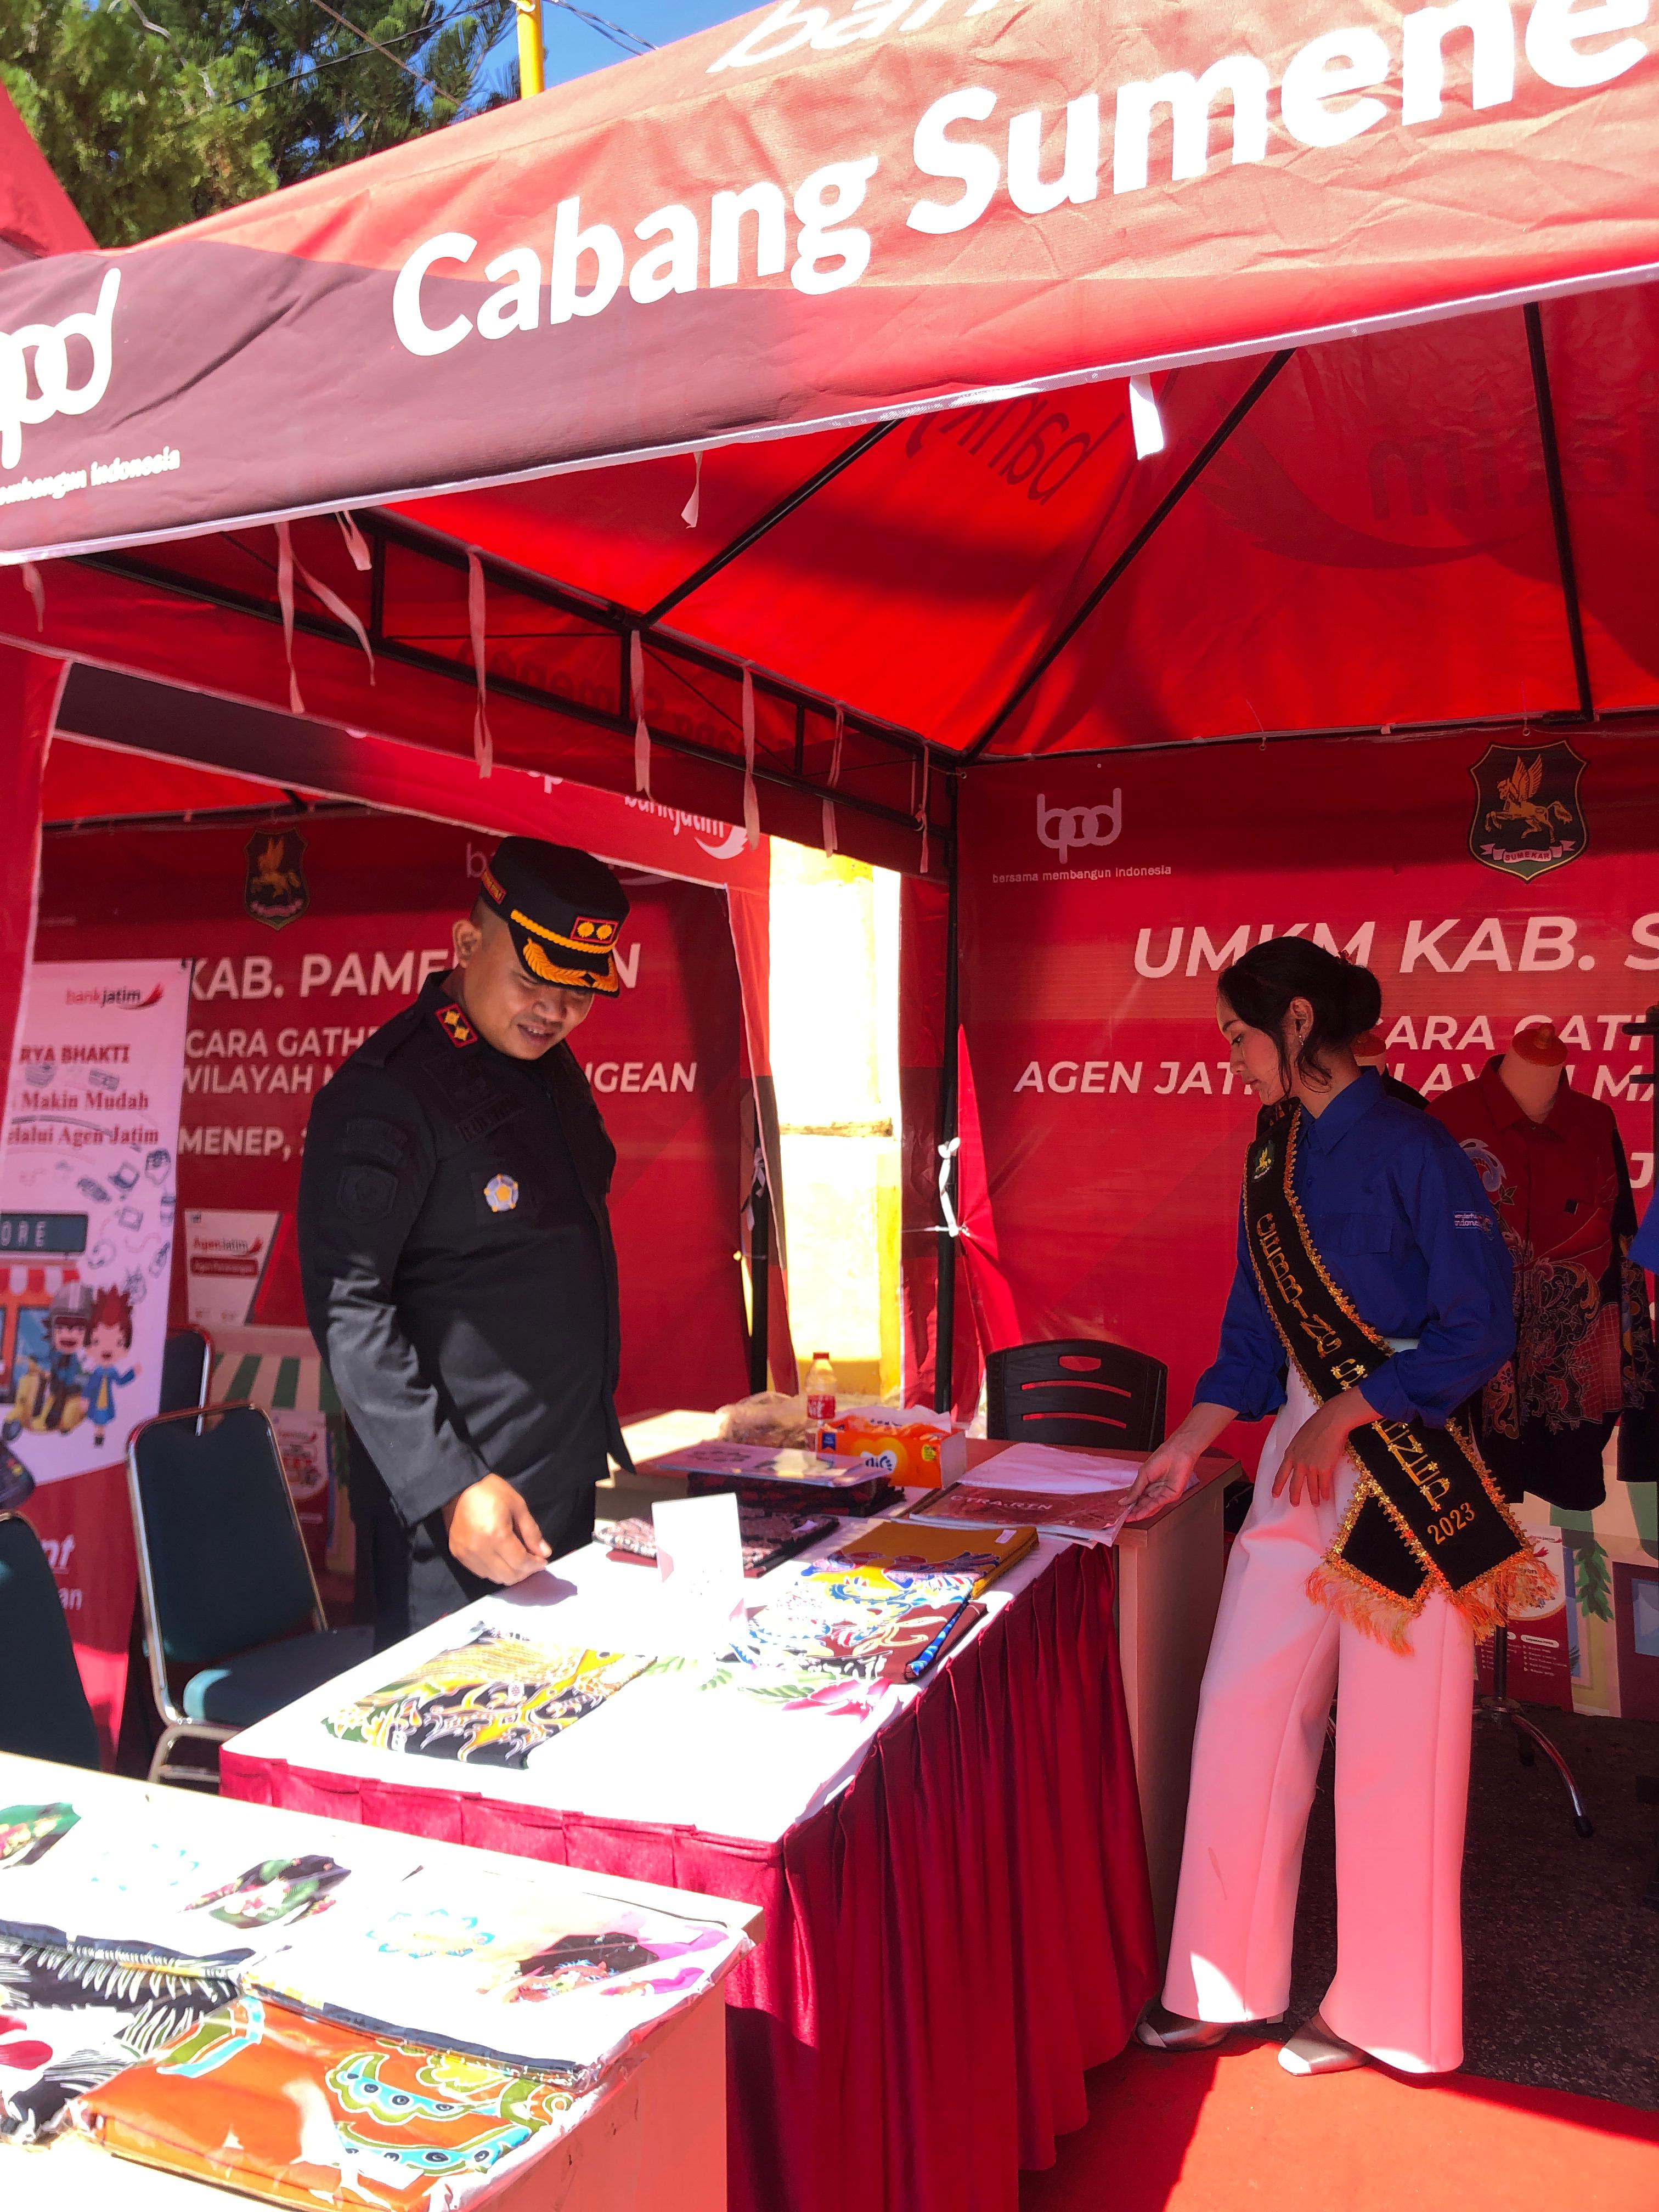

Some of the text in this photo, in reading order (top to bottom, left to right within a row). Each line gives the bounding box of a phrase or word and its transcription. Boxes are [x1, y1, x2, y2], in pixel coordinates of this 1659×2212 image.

[393, 0, 1648, 357] Cabang Sumene
[1504, 851, 1550, 861] SUMEKAR
[992, 872, 1039, 883] bersama
[1042, 869, 1111, 881] membangun
[1398, 916, 1595, 973] KAB.
[61, 1045, 130, 1063] BHAKTI
[277, 1025, 380, 1056] GATH
[1014, 1061, 1143, 1094] AGEN
[22, 1090, 149, 1110] Makin Mudah
[58, 1127, 104, 1148] Agen
[110, 1125, 159, 1145] Jatim
[1427, 1502, 1476, 1545] 2023
